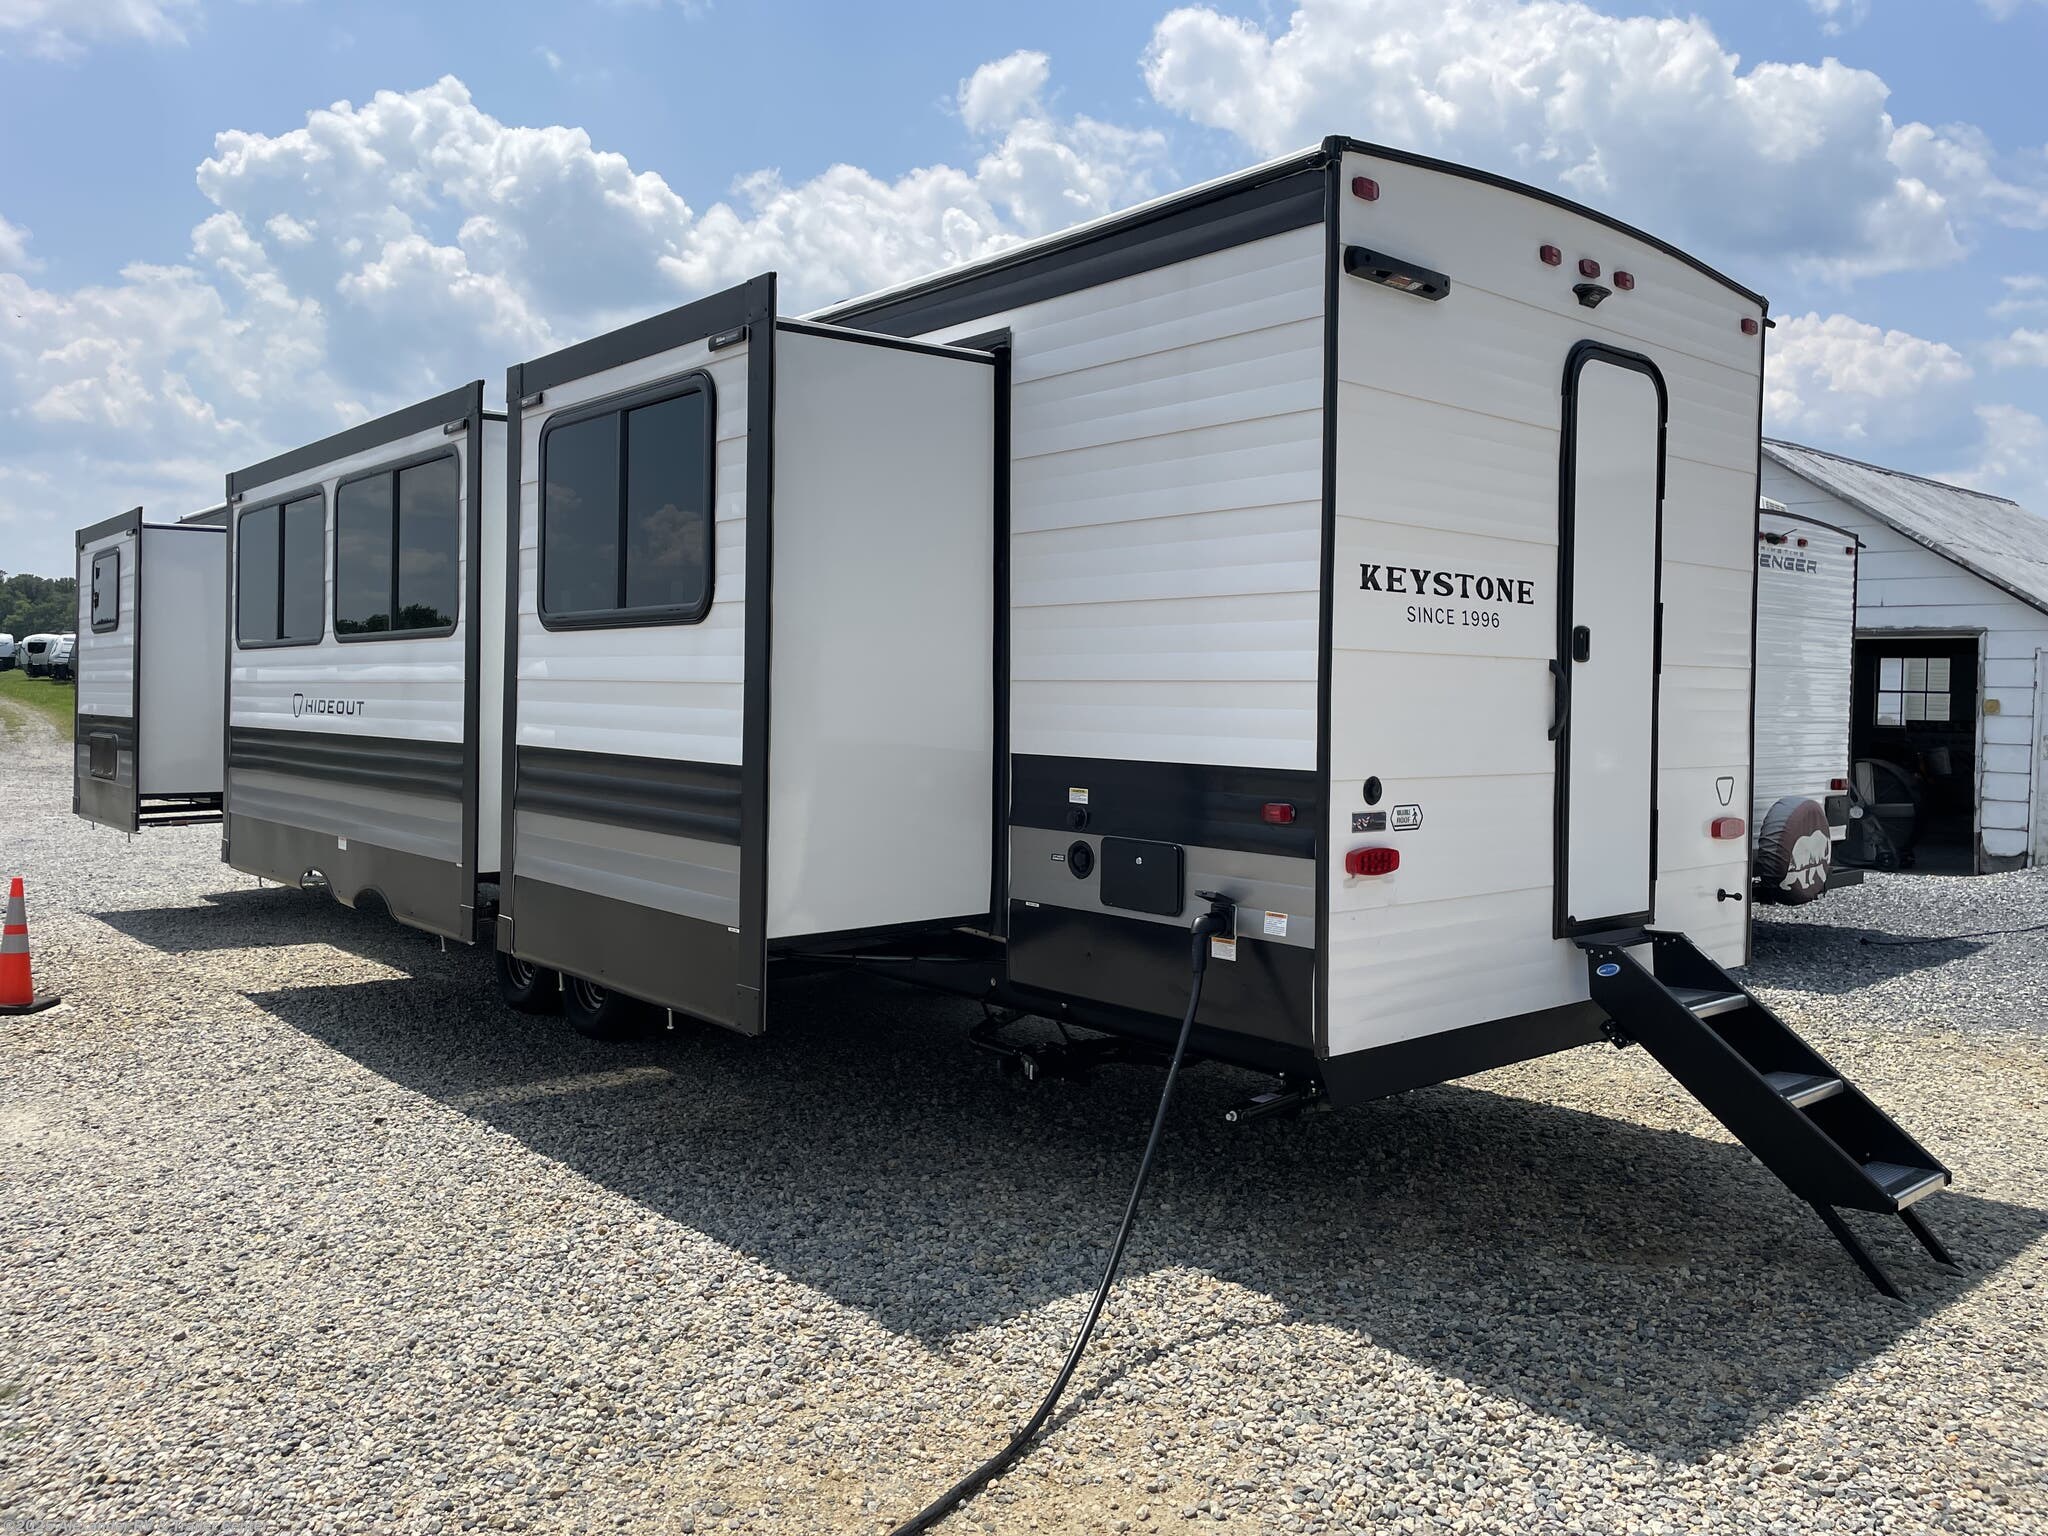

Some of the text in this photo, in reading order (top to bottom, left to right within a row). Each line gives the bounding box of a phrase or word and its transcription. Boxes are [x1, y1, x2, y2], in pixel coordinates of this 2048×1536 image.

[1760, 553, 1817, 574] ENGER
[1360, 563, 1535, 605] KEYSTONE
[1407, 605, 1500, 628] SINCE 1996
[305, 699, 365, 716] HIDEOUT
